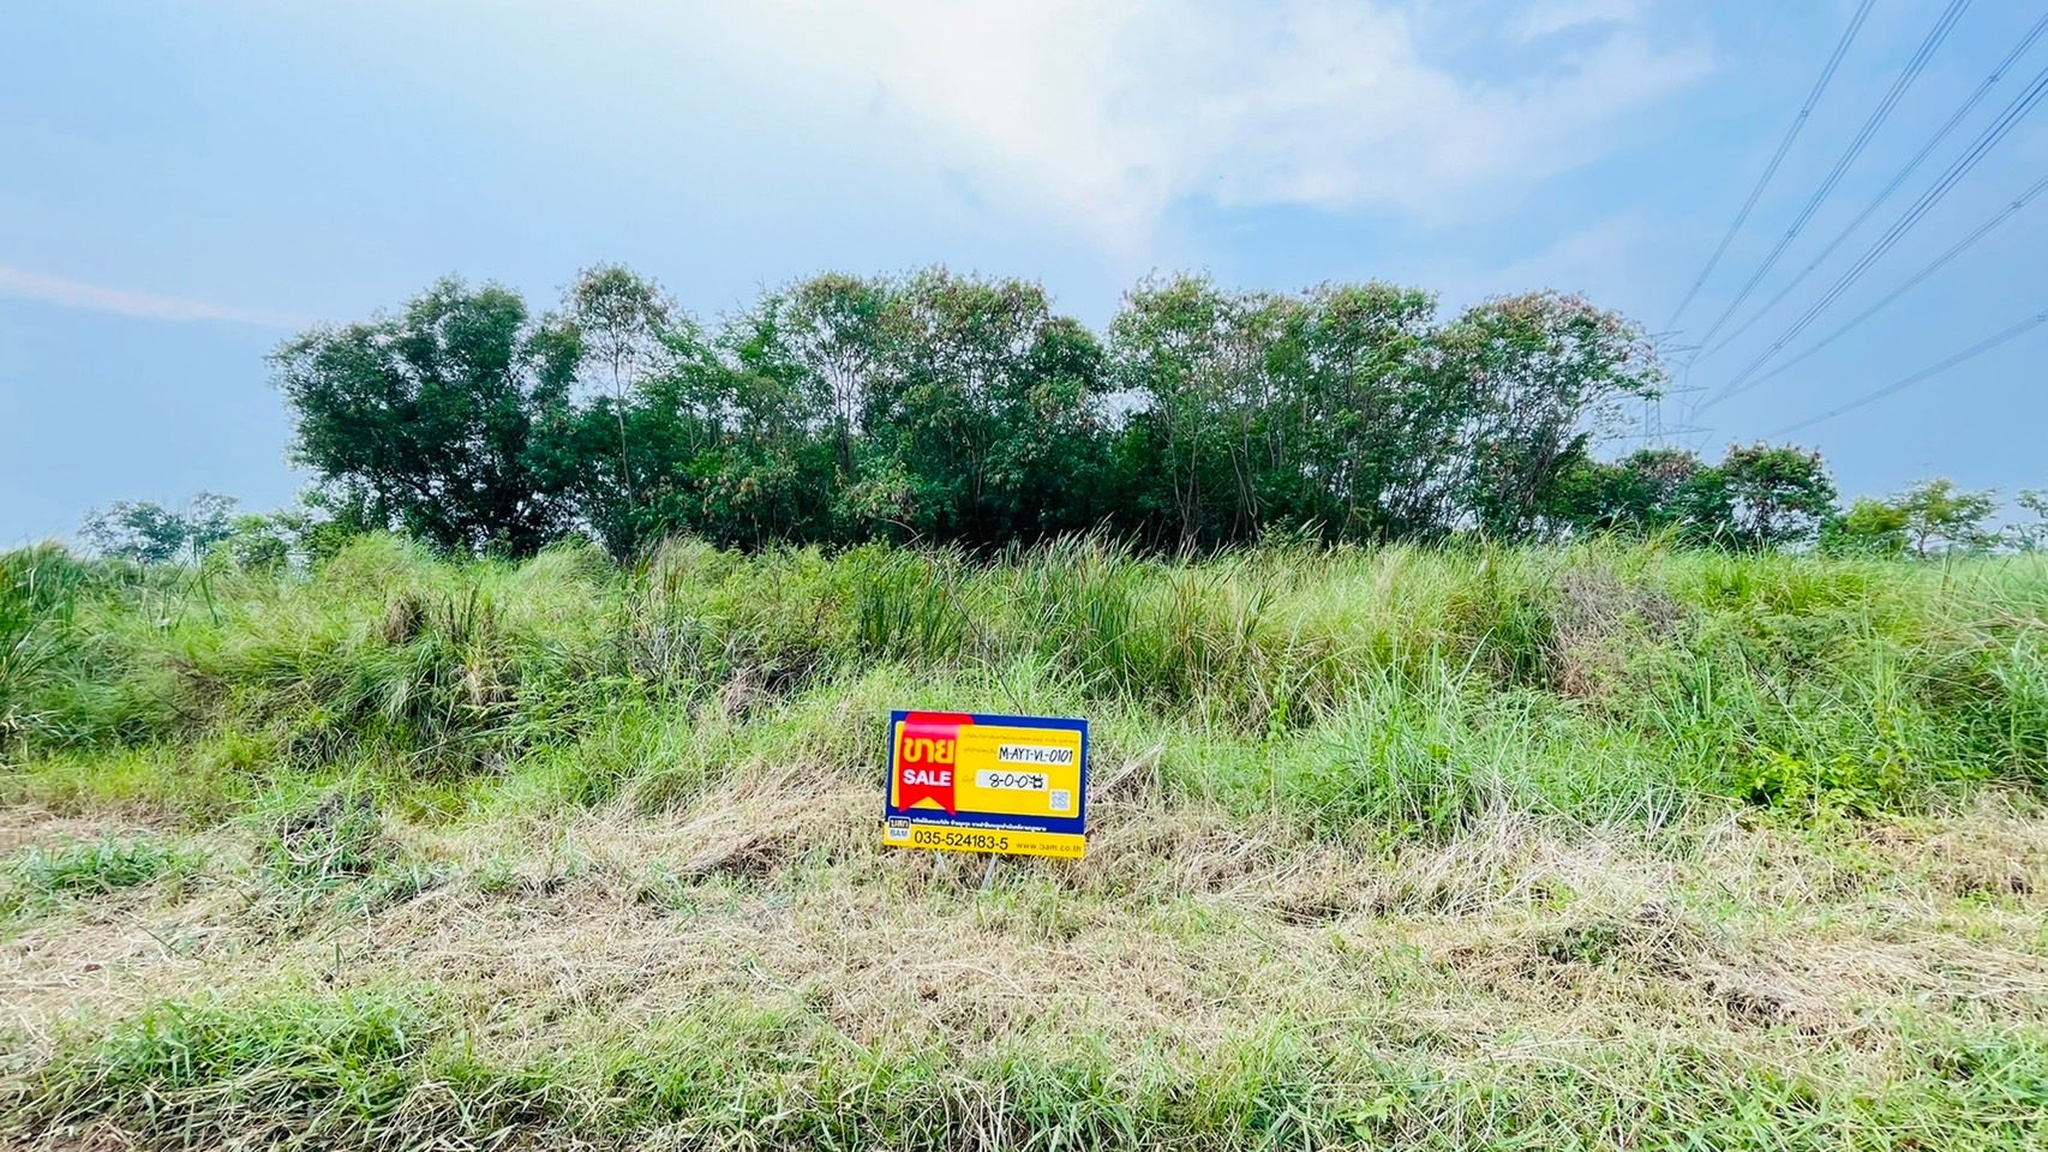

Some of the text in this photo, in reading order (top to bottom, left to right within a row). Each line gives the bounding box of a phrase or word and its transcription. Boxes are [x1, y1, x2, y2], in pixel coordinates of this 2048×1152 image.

[903, 737, 955, 764] ขาย
[903, 769, 952, 787] SALE
[914, 830, 1009, 850] 035-524183-5
